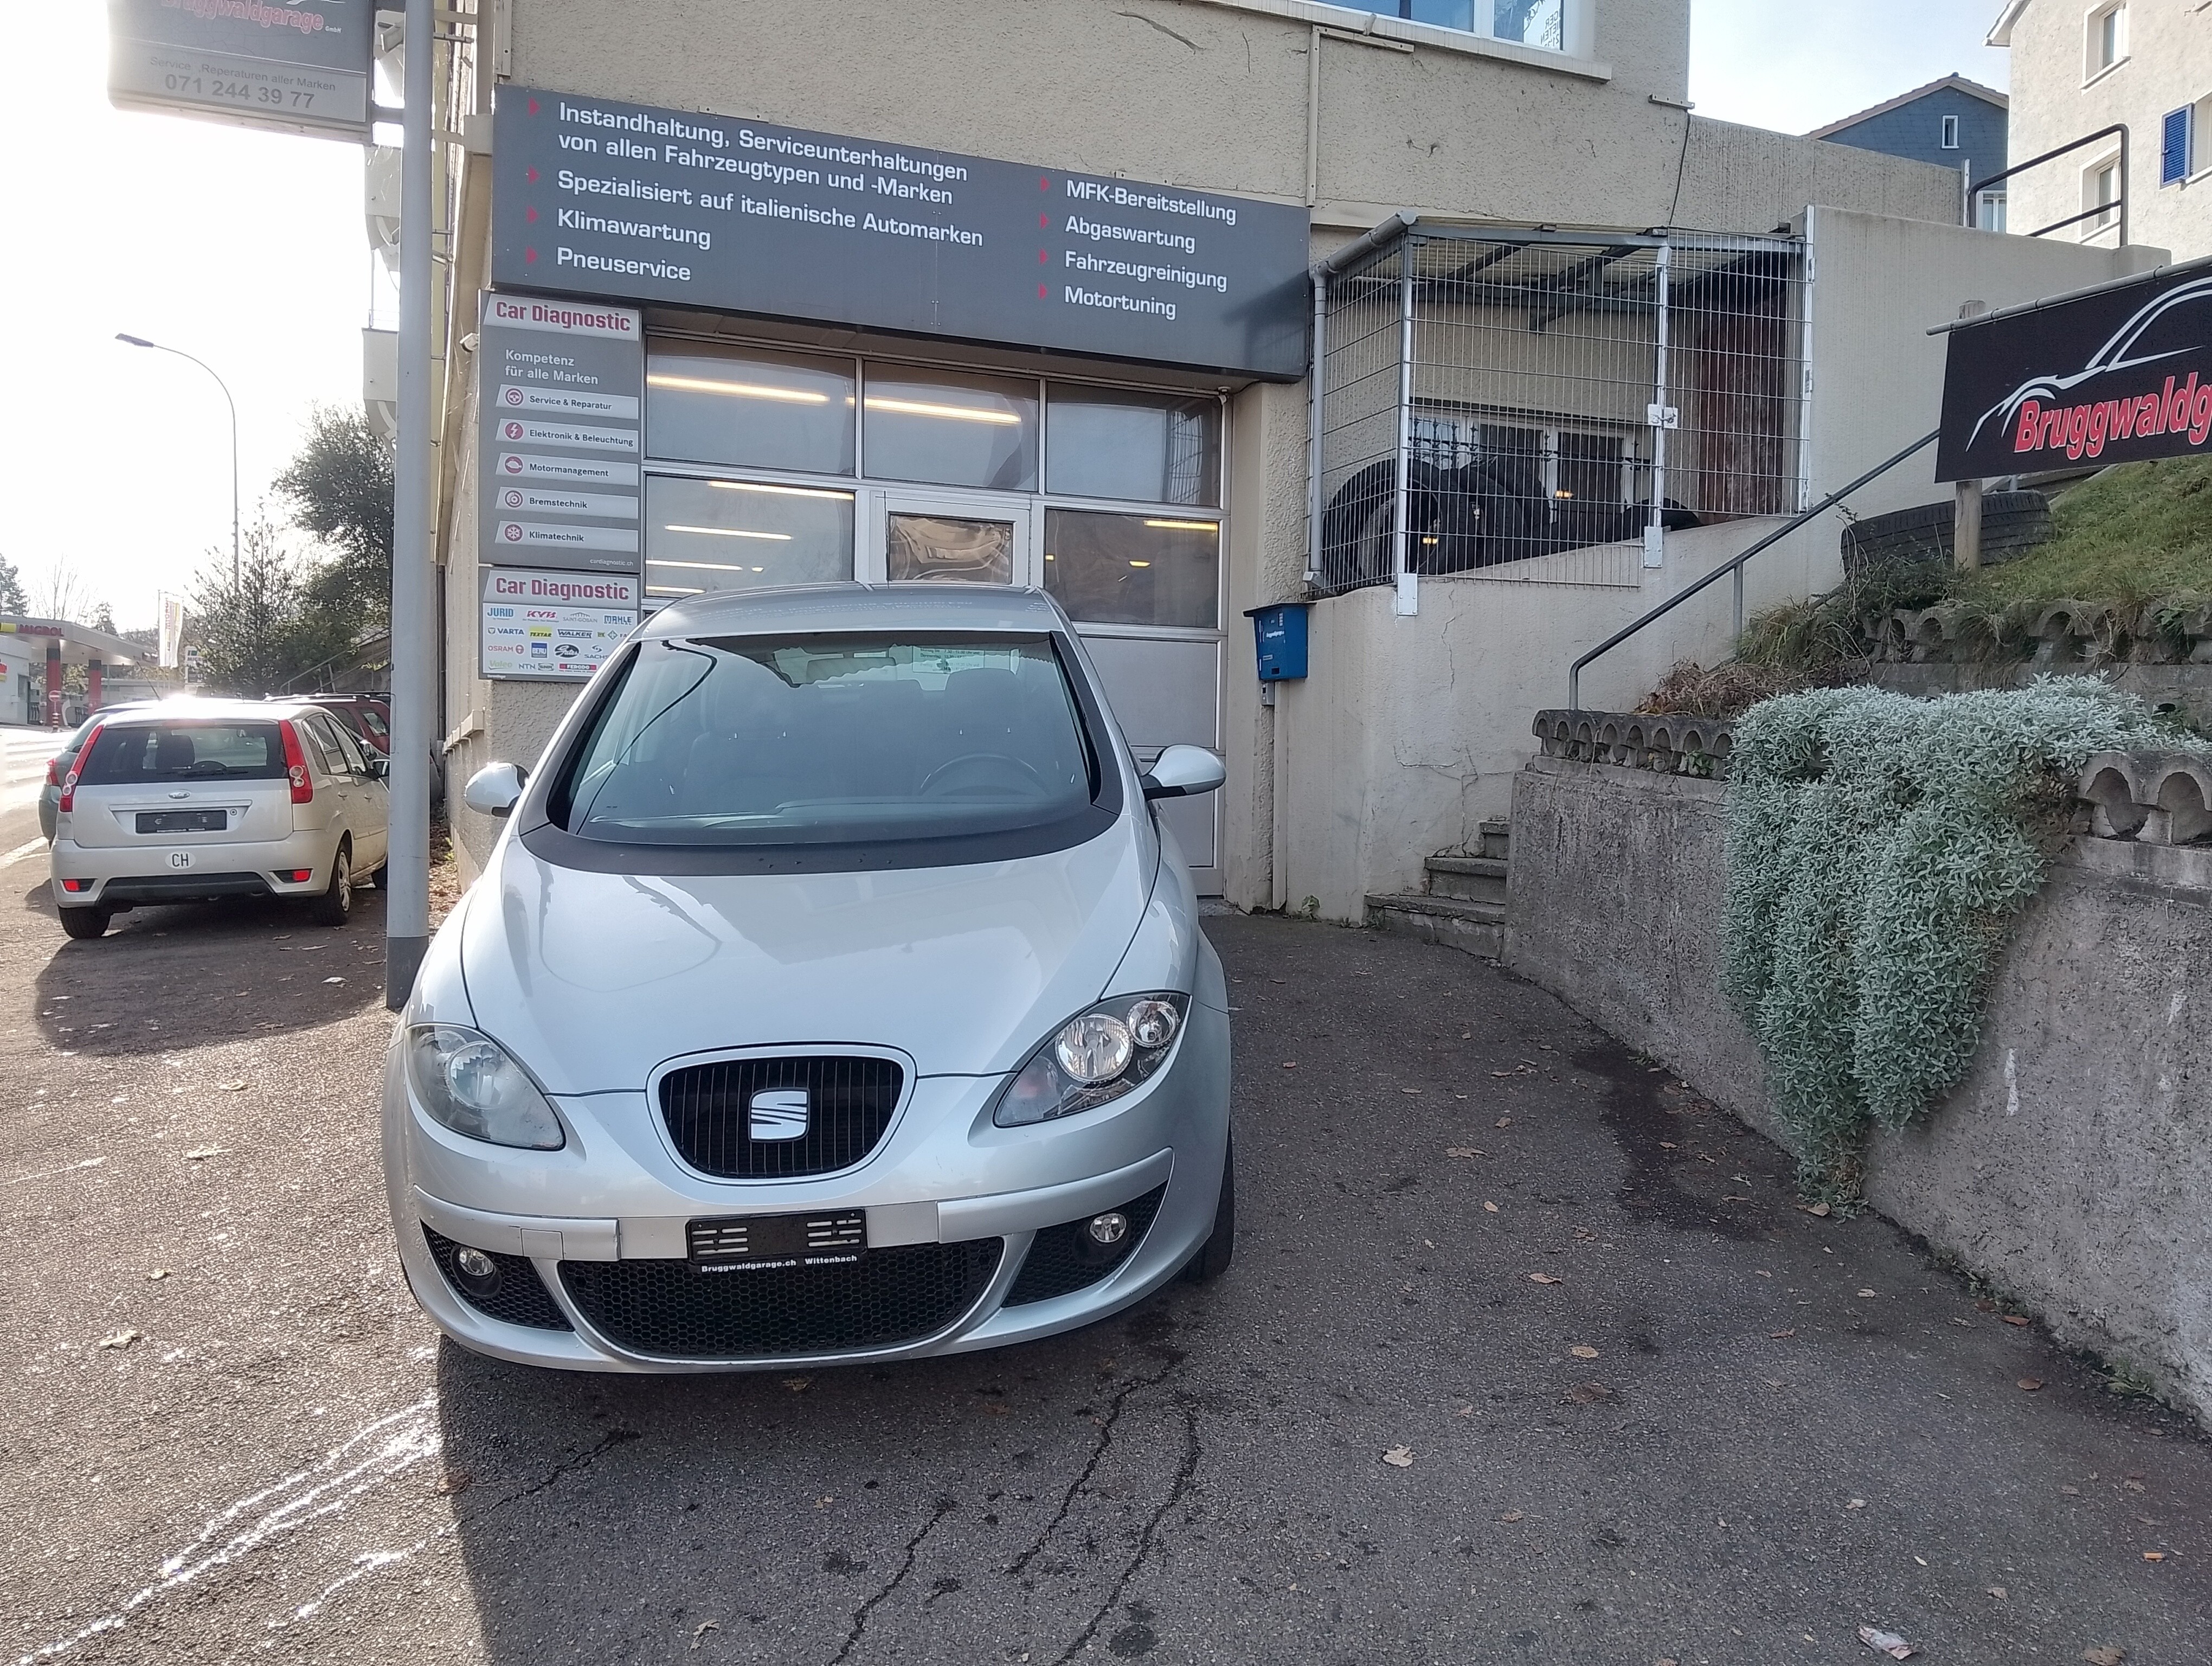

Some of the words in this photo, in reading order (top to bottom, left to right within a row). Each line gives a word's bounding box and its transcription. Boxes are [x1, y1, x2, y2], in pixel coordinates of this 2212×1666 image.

[325, 25, 342, 34] GmbH
[150, 56, 191, 71] Service
[271, 74, 294, 85] aller
[297, 78, 336, 91] Marken
[165, 74, 202, 94] 071
[211, 80, 250, 101] 244
[258, 86, 283, 105] 39
[290, 90, 315, 108] 77
[559, 101, 730, 149] Instandhaltung,
[738, 129, 968, 183] Serviceunterhaltungen
[558, 134, 597, 153] von
[606, 138, 657, 162] allen
[665, 145, 820, 187] Fahrzeugtypen
[827, 172, 865, 193] und
[871, 177, 953, 205] -Marken
[558, 170, 693, 206] Spezialisiert
[699, 191, 734, 212] auf
[741, 195, 856, 229] italienische
[862, 213, 983, 247] Automarken
[1066, 179, 1236, 226] MFK-Bereitstellung
[557, 209, 711, 251] Klimawartung
[1065, 215, 1195, 254] Abgaswartung
[556, 247, 691, 281] Pneuservice
[1065, 251, 1227, 292] Fahrzeugreinigung
[1065, 286, 1176, 321] Motortuning
[496, 302, 526, 320] Car
[532, 305, 631, 331] Diagnostic
[505, 349, 575, 367] Kompetenz
[505, 366, 524, 377] für
[527, 368, 549, 380] alle
[553, 370, 598, 385] Marken
[529, 395, 561, 406] Service
[571, 400, 612, 410] Reparatur
[530, 430, 572, 440] Elektronik
[583, 434, 634, 447] Beleuchtung
[529, 463, 609, 477] Motormanagement
[529, 497, 587, 509] Bremstechnik
[529, 531, 584, 542] Klimatechnik
[496, 578, 526, 594] Car
[531, 579, 629, 601] Diagnostic
[487, 608, 513, 617] JURID
[557, 630, 591, 638] WALKER
[172, 854, 189, 867] CH
[702, 1259, 796, 1273] Bruggwaldgarage.ch
[805, 1255, 857, 1265] Wittenbach
